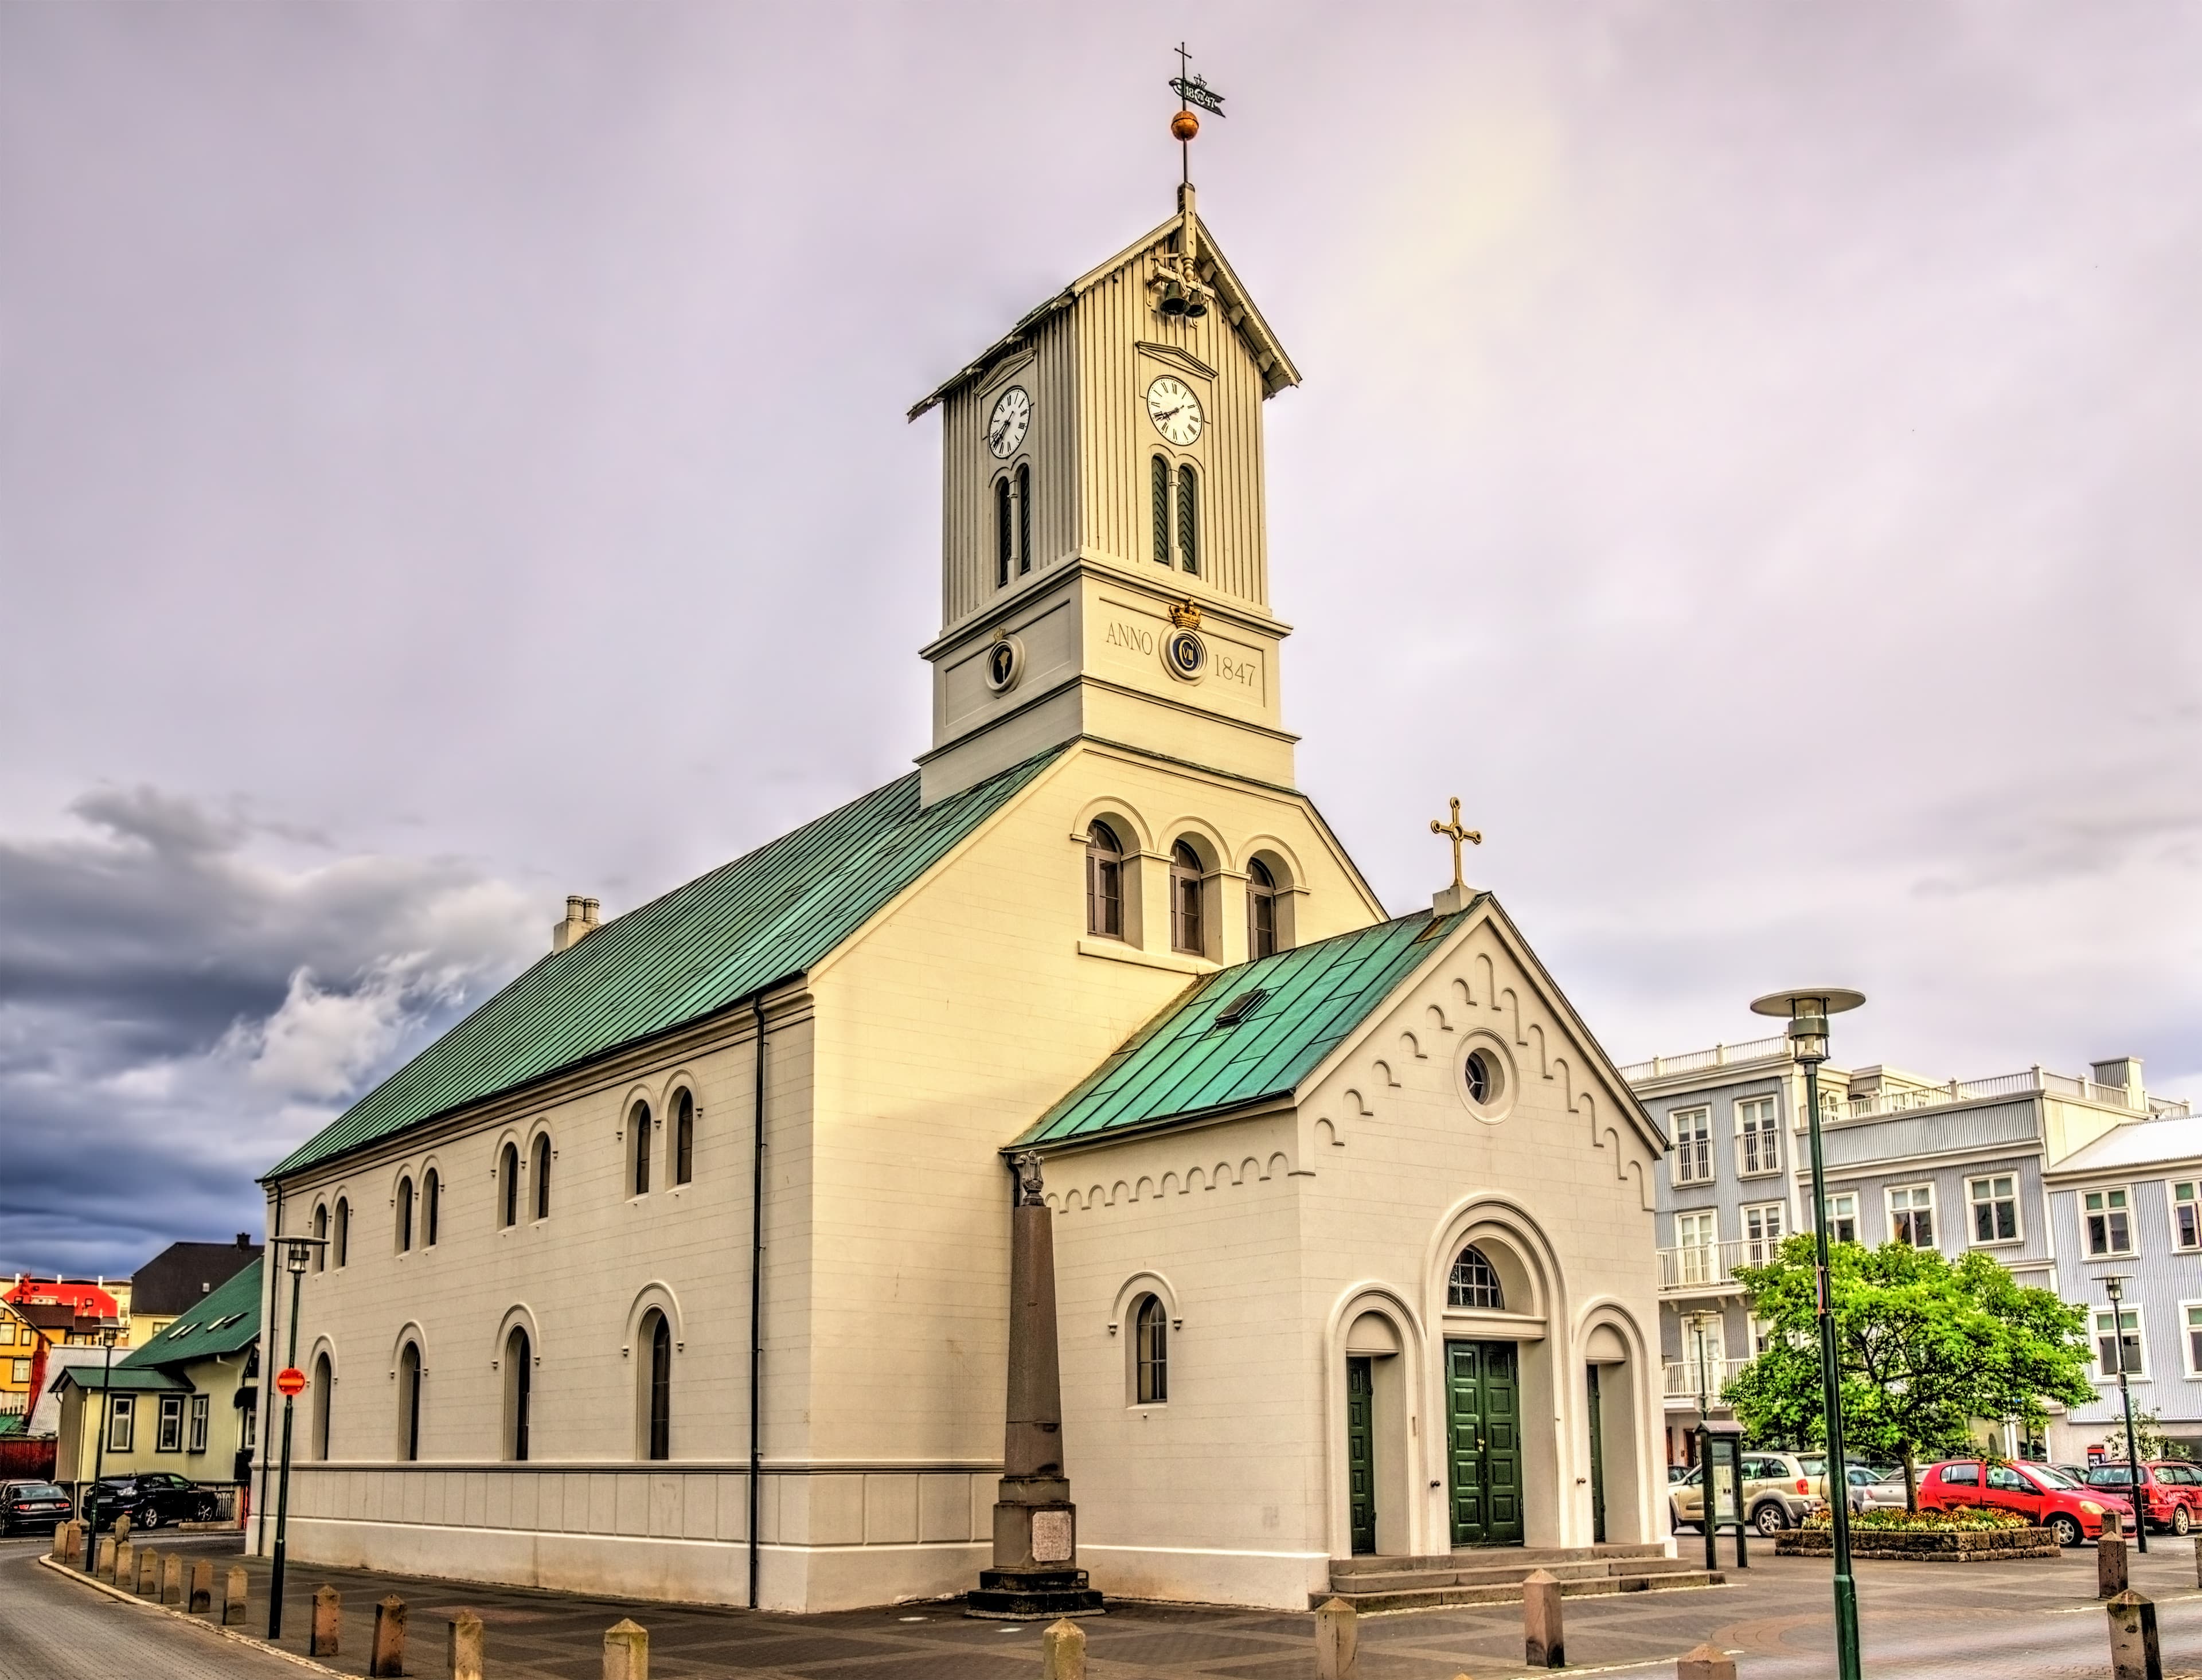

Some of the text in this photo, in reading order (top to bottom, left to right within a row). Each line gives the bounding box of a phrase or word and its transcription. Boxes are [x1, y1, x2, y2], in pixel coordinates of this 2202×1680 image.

[1186, 86, 1194, 98] 18
[1205, 96, 1215, 108] 47
[1106, 622, 1153, 655] ANNO
[1215, 654, 1256, 687] 1847
